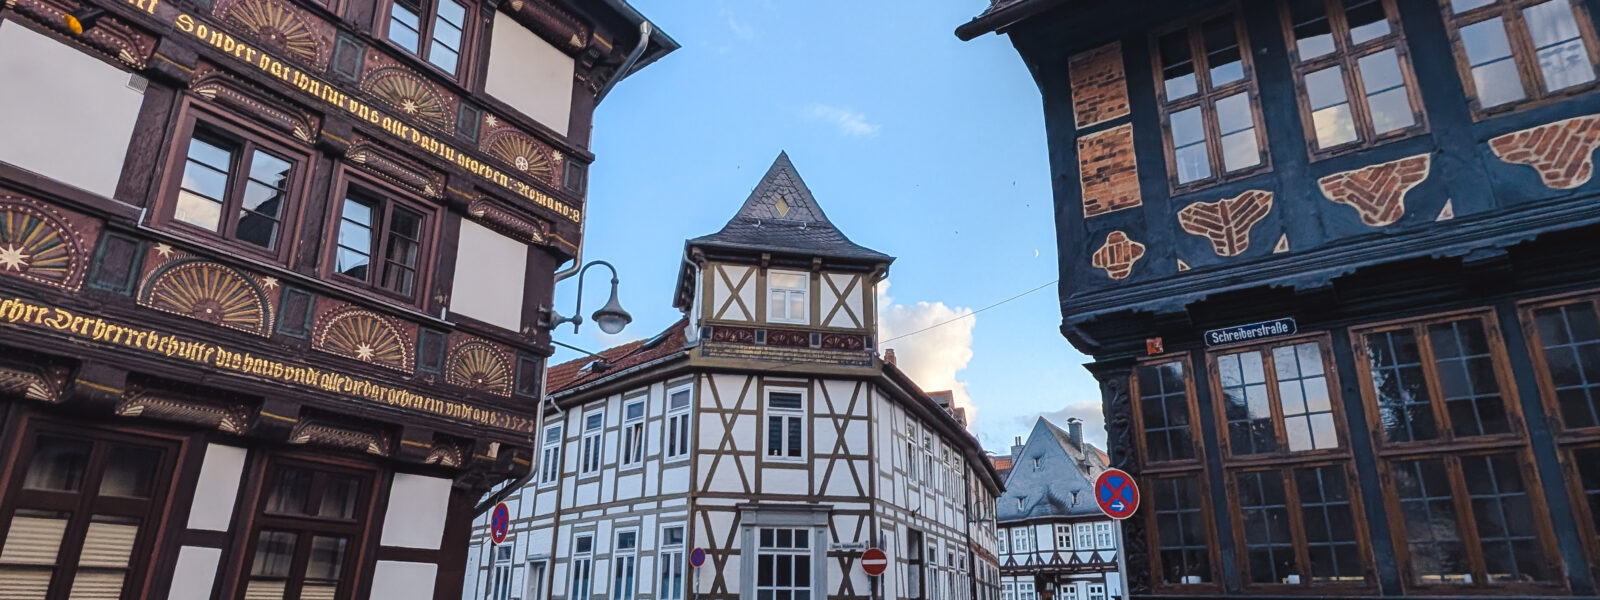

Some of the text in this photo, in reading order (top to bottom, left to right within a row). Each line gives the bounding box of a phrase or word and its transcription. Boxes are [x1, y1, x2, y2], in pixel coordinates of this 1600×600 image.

[175, 14, 257, 63] Sonder
[259, 53, 290, 80] hat
[382, 117, 410, 139] alle
[1211, 321, 1288, 344] Schreiberstraße
[242, 353, 283, 378] haus
